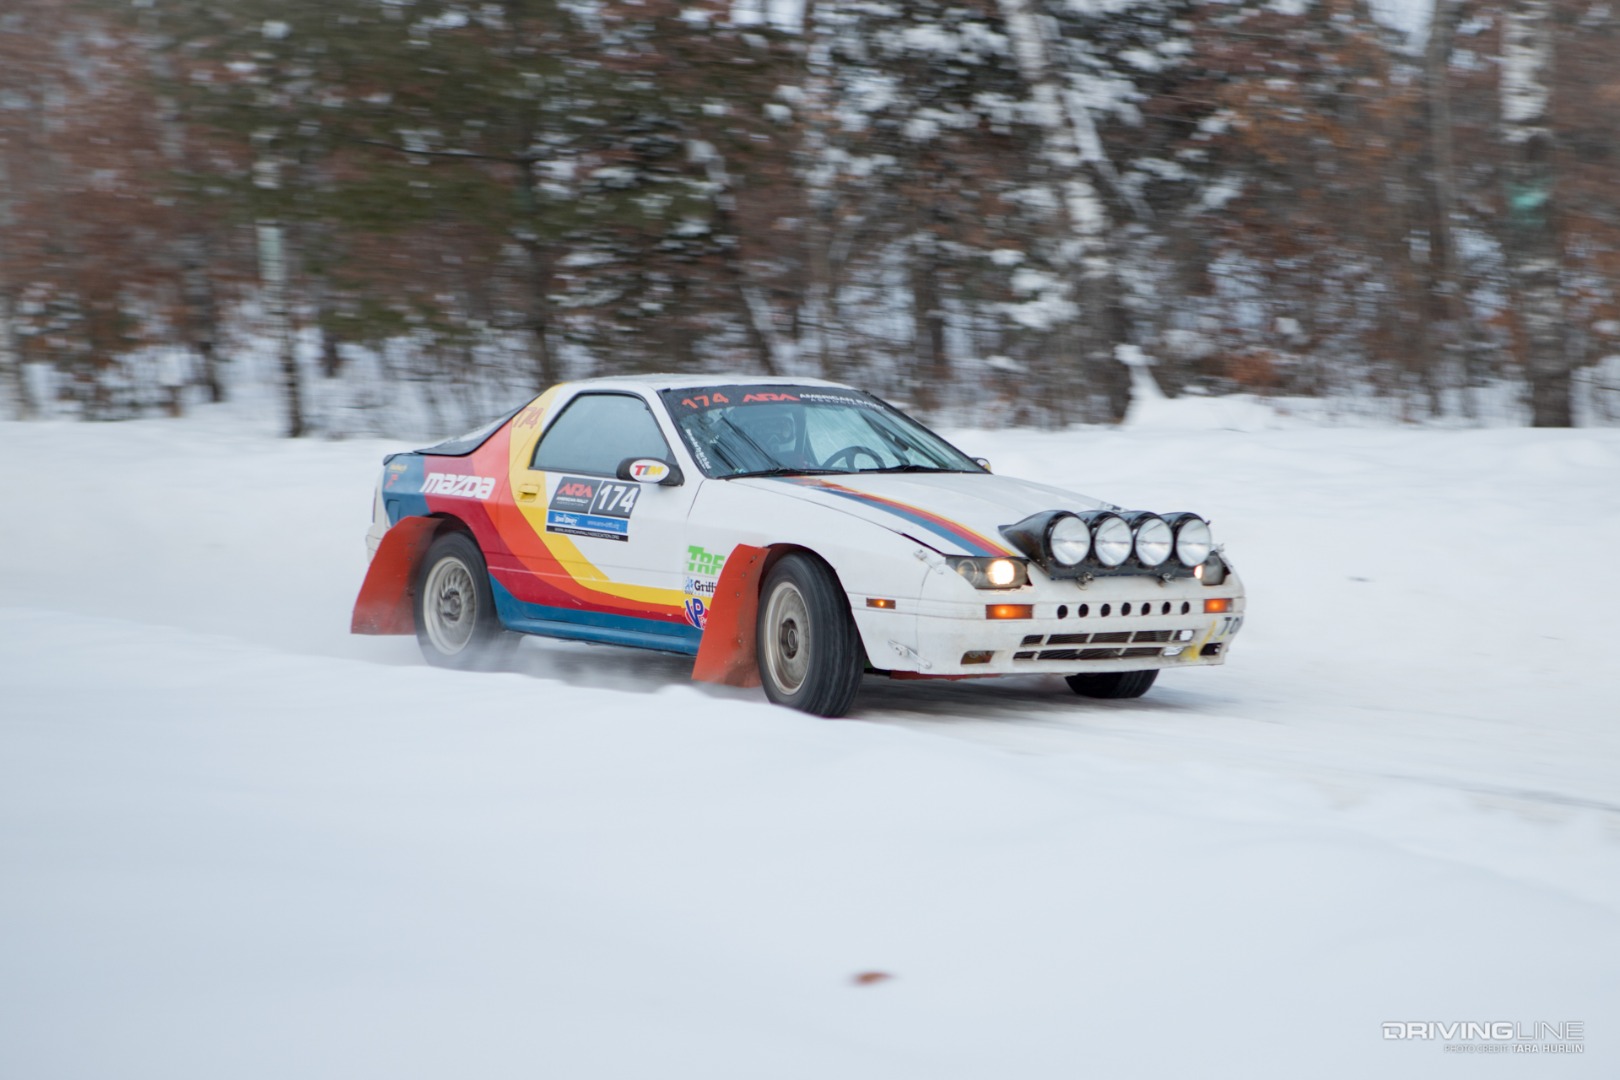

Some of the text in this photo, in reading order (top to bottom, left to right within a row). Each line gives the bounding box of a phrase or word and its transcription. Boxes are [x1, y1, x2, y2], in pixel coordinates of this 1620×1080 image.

[682, 393, 729, 409] 174
[800, 393, 854, 404] AMERICAN
[635, 465, 664, 476] TIM
[600, 485, 638, 512] 174
[685, 598, 704, 628] VP
